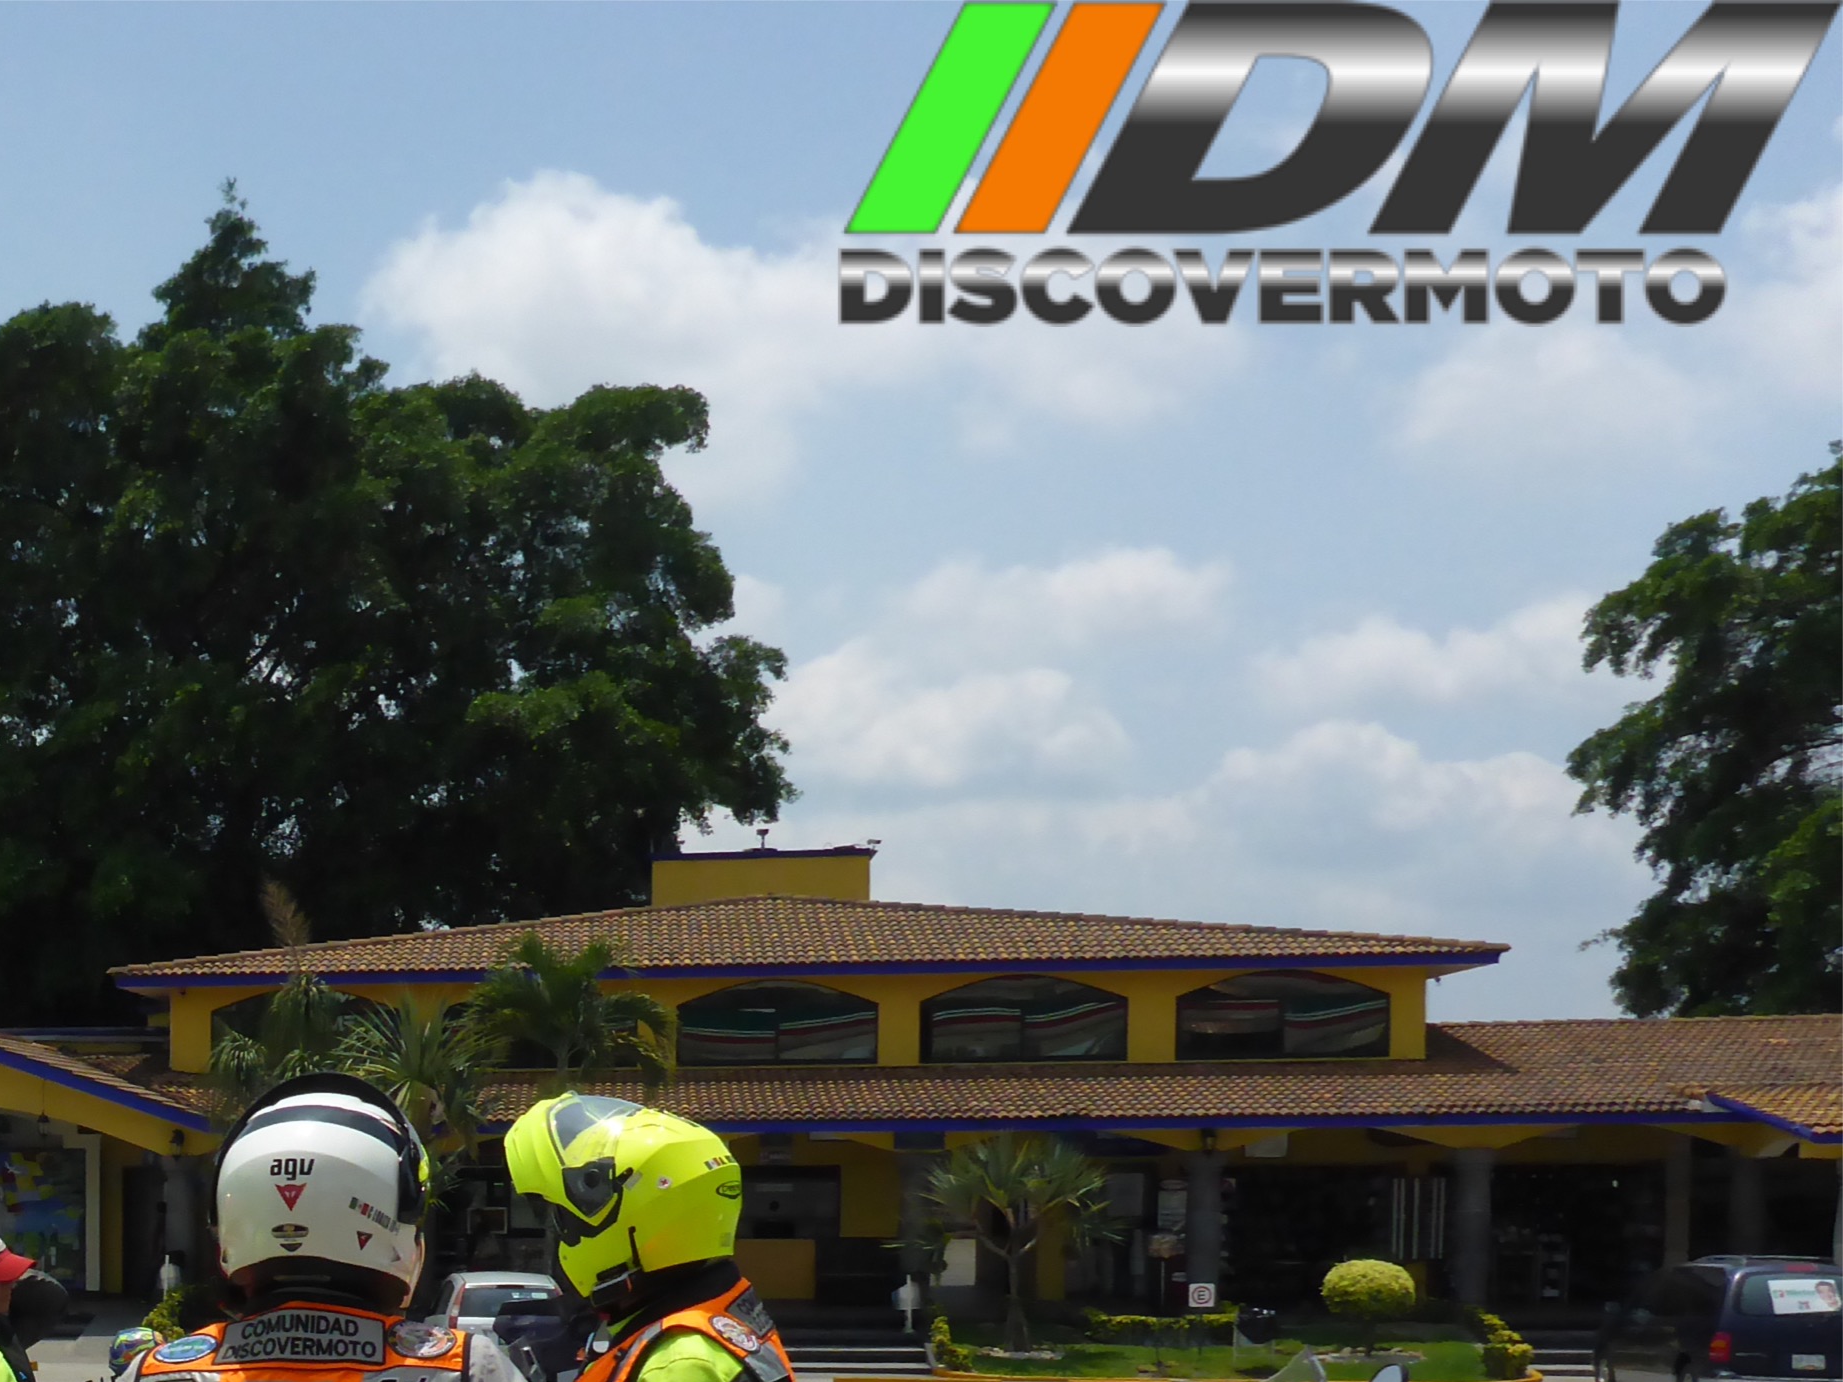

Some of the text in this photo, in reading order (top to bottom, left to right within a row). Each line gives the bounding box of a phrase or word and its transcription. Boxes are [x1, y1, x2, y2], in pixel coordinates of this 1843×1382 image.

[270, 1158, 315, 1181] agv
[1197, 1290, 1206, 1301] E
[241, 1313, 359, 1340] COMUNIDAD
[222, 1336, 376, 1360] DISCOVERMOTO
